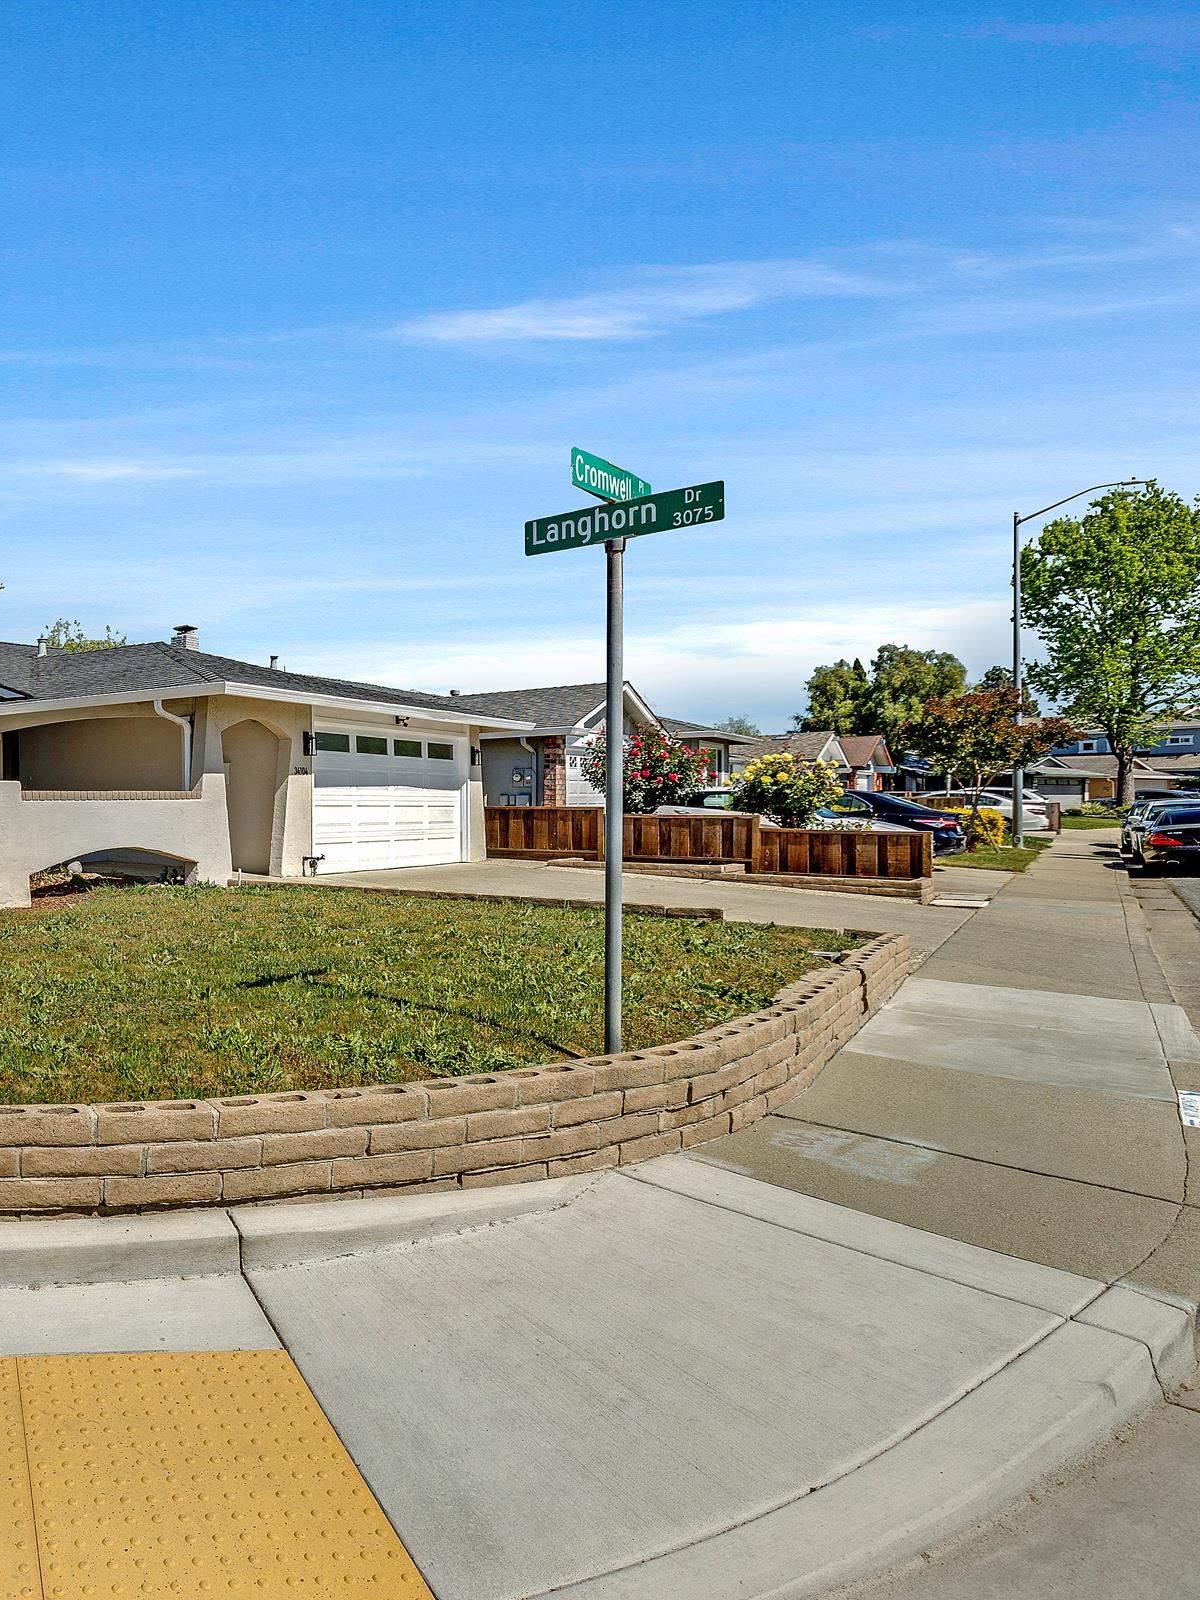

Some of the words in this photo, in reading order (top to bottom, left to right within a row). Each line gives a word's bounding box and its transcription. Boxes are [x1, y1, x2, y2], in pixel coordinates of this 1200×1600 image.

[575, 454, 632, 500] Cromwell
[532, 502, 657, 545] Langhorn
[684, 489, 702, 504] Dr
[672, 505, 714, 526] 3075
